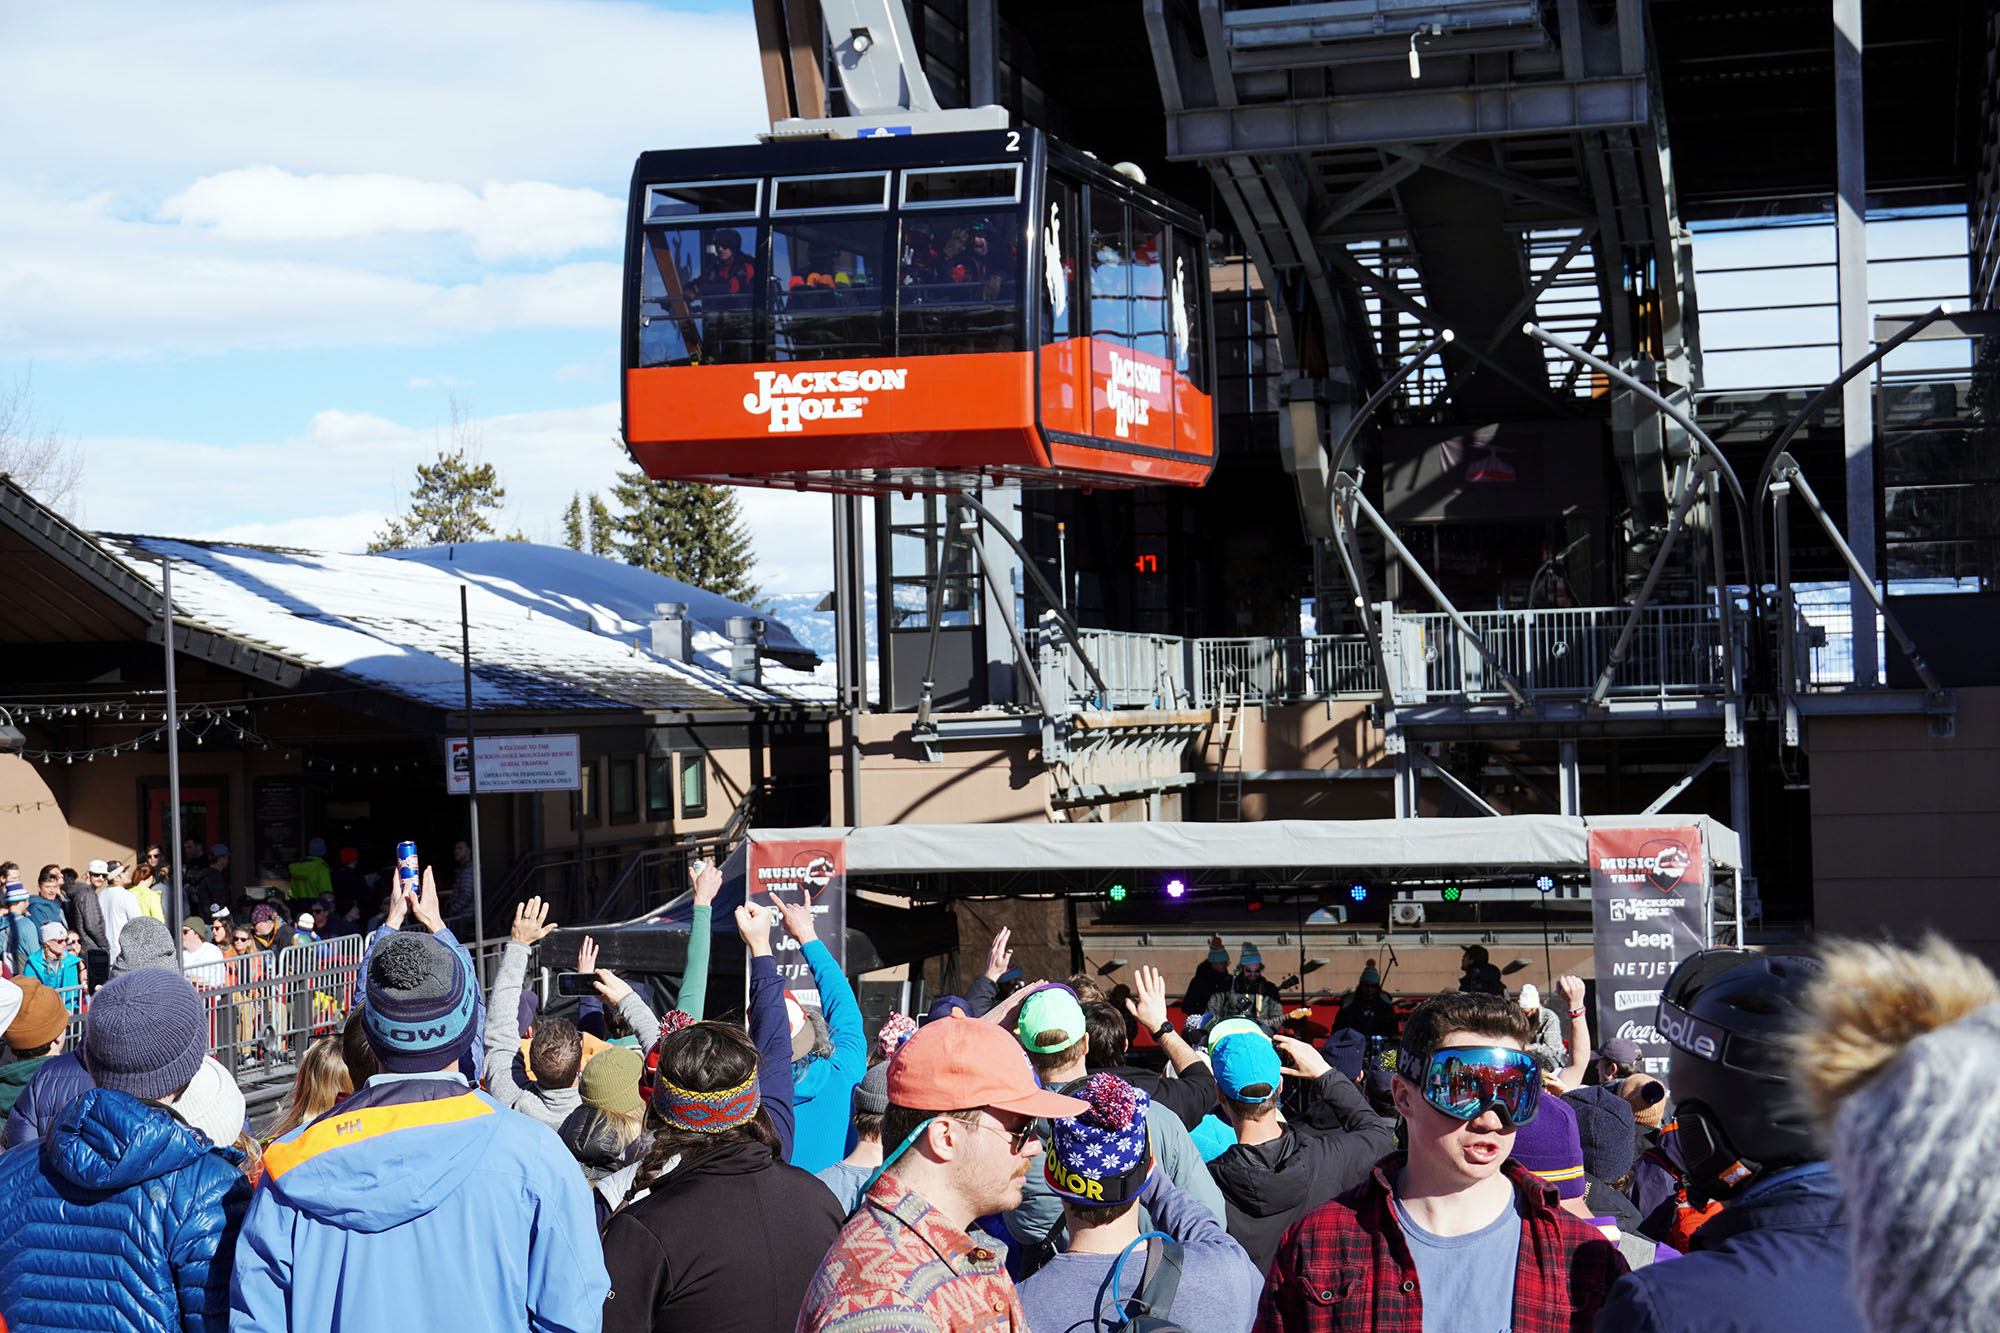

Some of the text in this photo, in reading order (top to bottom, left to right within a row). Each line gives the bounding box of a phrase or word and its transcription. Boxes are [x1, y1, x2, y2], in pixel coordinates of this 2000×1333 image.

[1005, 131, 1020, 152] 2
[1106, 351, 1161, 409] JACKSON
[743, 368, 908, 414] JACKSON
[1115, 388, 1150, 438] HOLE
[528, 743, 537, 751] TO
[476, 753, 501, 761] JACKSON
[502, 752, 518, 760] HOLE
[1600, 857, 1655, 870] MUSIC
[758, 867, 807, 879] MUSIC
[1610, 874, 1646, 883] TRAM
[766, 883, 798, 891] TRAM
[1626, 898, 1686, 915] JACKSON
[1634, 907, 1670, 921] HOLE
[1624, 930, 1673, 950] Jeep
[1613, 961, 1677, 979] NETJET
[336, 1118, 363, 1137] HH
